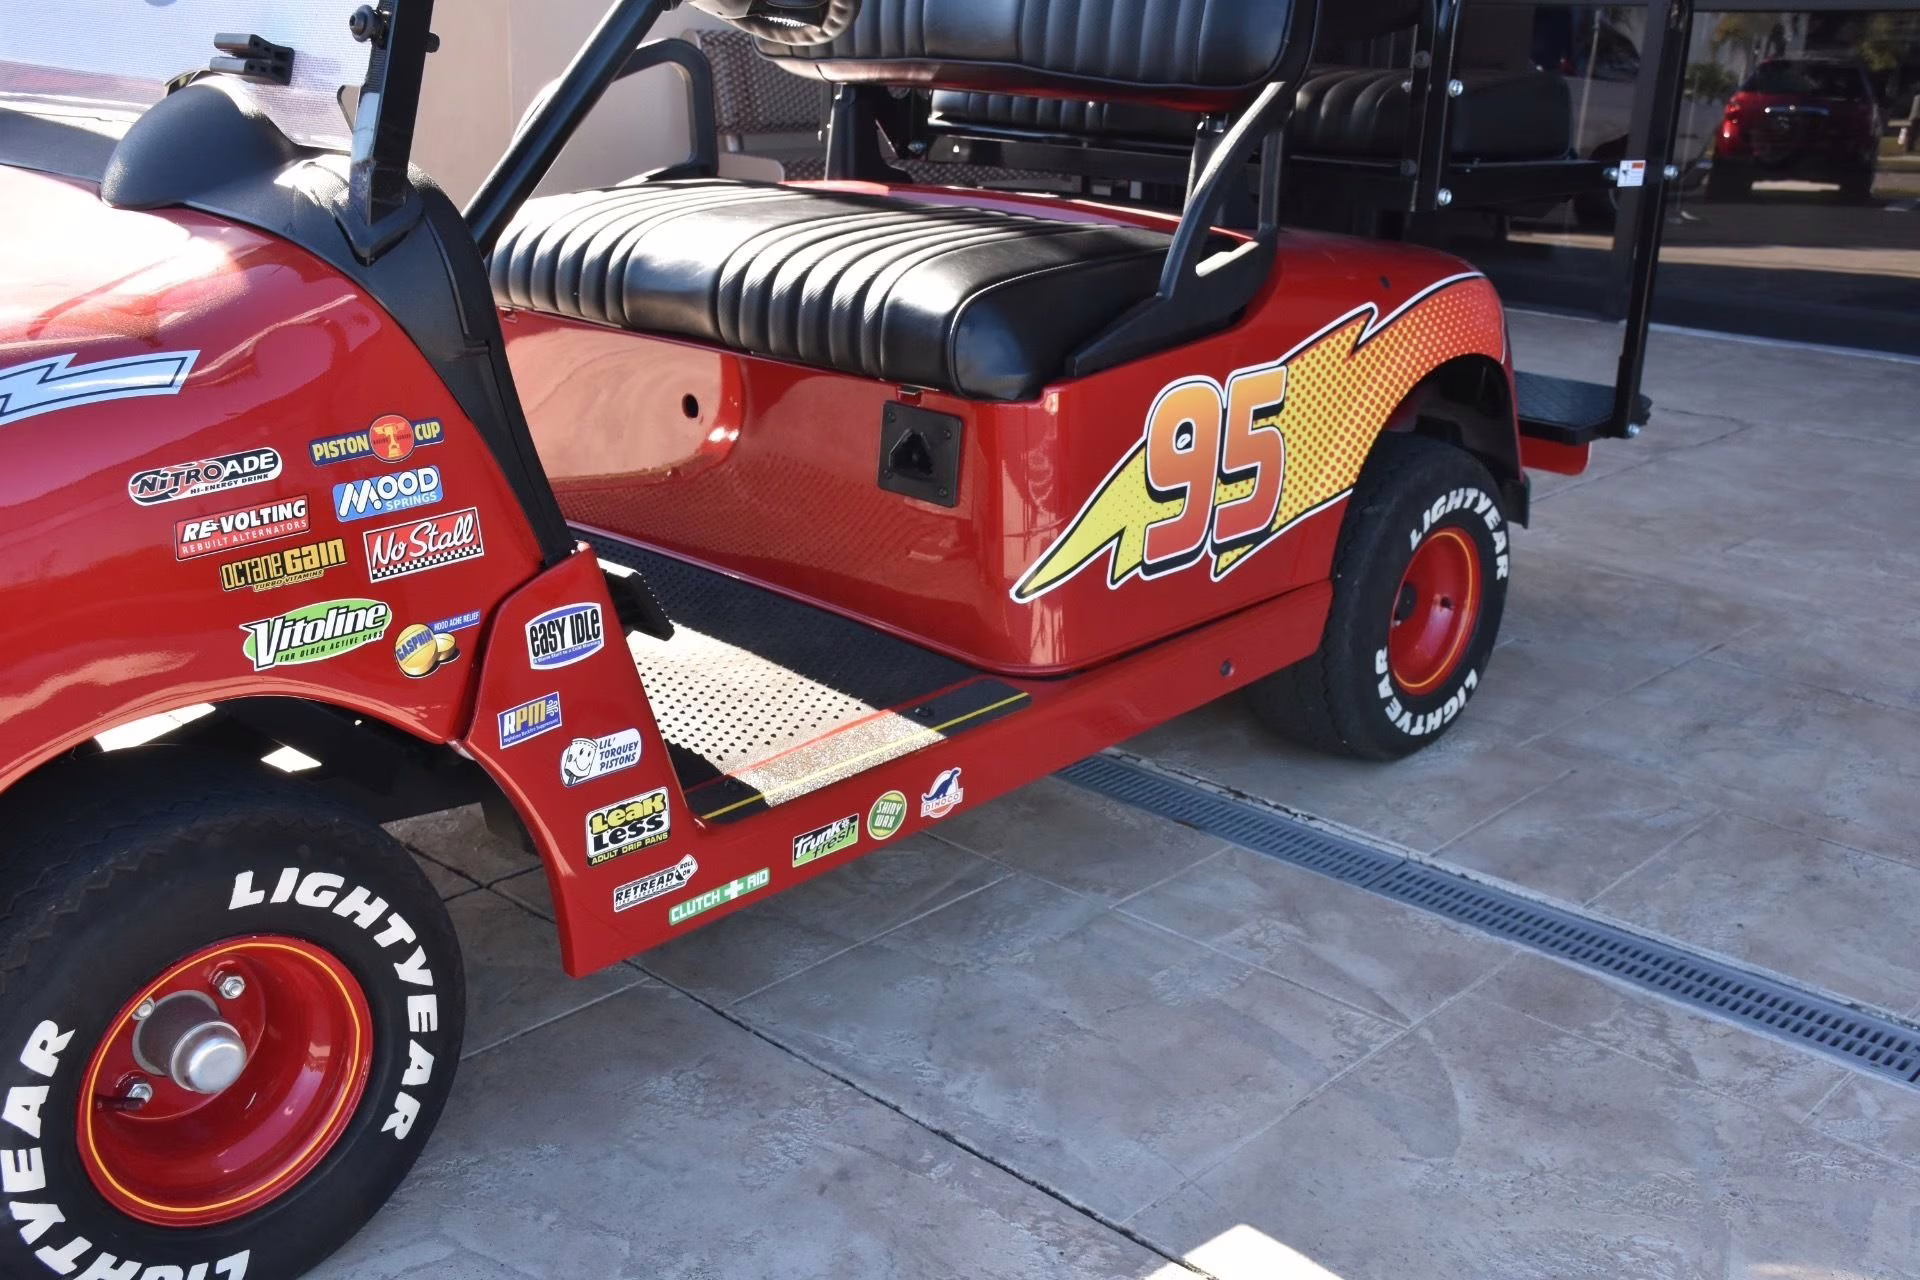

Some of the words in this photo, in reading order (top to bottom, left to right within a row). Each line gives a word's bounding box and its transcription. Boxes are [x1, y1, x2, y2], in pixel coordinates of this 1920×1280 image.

[312, 434, 369, 462] PISTON
[414, 421, 441, 441] CUP
[1144, 365, 1288, 565] 95
[190, 480, 238, 495] HI-ENERGY
[241, 473, 269, 485] DRINK
[338, 466, 439, 517] MOOD
[385, 491, 438, 511] SPRINGS
[182, 537, 229, 554] REBUILT
[232, 519, 307, 544] ALTERNATORS
[372, 531, 407, 569] No
[409, 513, 475, 558] Stall
[1409, 487, 1509, 580] LIGHTYEAR
[255, 579, 283, 590] TURBO
[285, 569, 323, 582] VITAMINS
[243, 602, 388, 669] Vitoline
[433, 620, 449, 631] HOOD
[449, 615, 463, 627] ACHE
[463, 611, 480, 623] RELIEF
[279, 652, 296, 662] FOR
[300, 645, 326, 657] OLDER
[330, 636, 358, 651] ACTIVE
[362, 630, 383, 641] CARS
[396, 628, 434, 662] GASPRIN
[1375, 646, 1479, 736] LIGHTYEAR
[503, 699, 546, 737] RPM
[599, 736, 616, 750] LIL'
[600, 740, 639, 760] TORQUEY
[600, 752, 637, 772] PISTONS
[876, 801, 903, 816] SHINY
[925, 793, 959, 811] DINOCO
[874, 814, 896, 828] WAX
[591, 849, 619, 865] ADULT
[622, 841, 643, 854] DRIP
[645, 831, 669, 845] PANS
[813, 822, 856, 858] fresh
[679, 860, 694, 870] ROLL
[615, 872, 675, 902] RETREAD
[671, 890, 721, 922] CLUTCH
[746, 870, 769, 891] AID
[228, 867, 438, 1140] LIGHTYEAR
